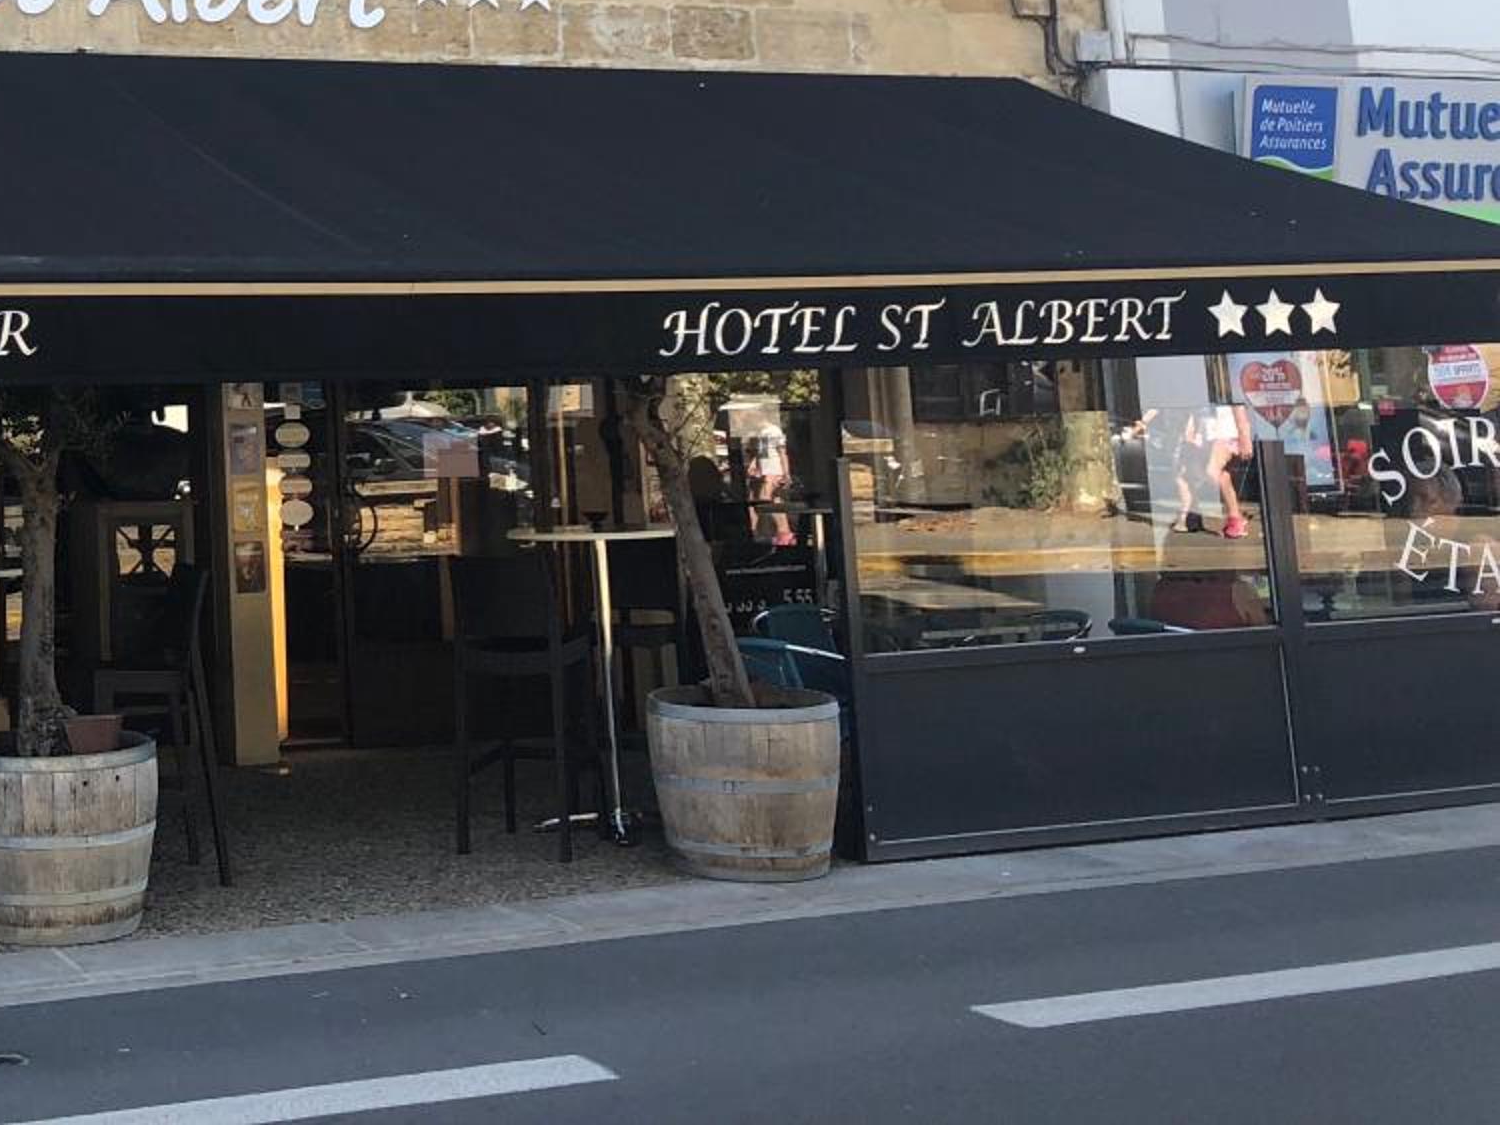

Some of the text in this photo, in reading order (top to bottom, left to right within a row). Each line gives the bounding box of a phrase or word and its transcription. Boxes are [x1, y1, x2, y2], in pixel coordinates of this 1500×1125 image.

[1260, 117, 1323, 132] de Poitiers
[1261, 98, 1316, 114] Mutuelle
[1358, 86, 1500, 141] Mutue
[1259, 135, 1327, 150] Assurances
[660, 290, 1186, 357] HOTEL ST ALBERT
[1368, 416, 1500, 506] SOIR
[1395, 516, 1500, 594] ÉTA
